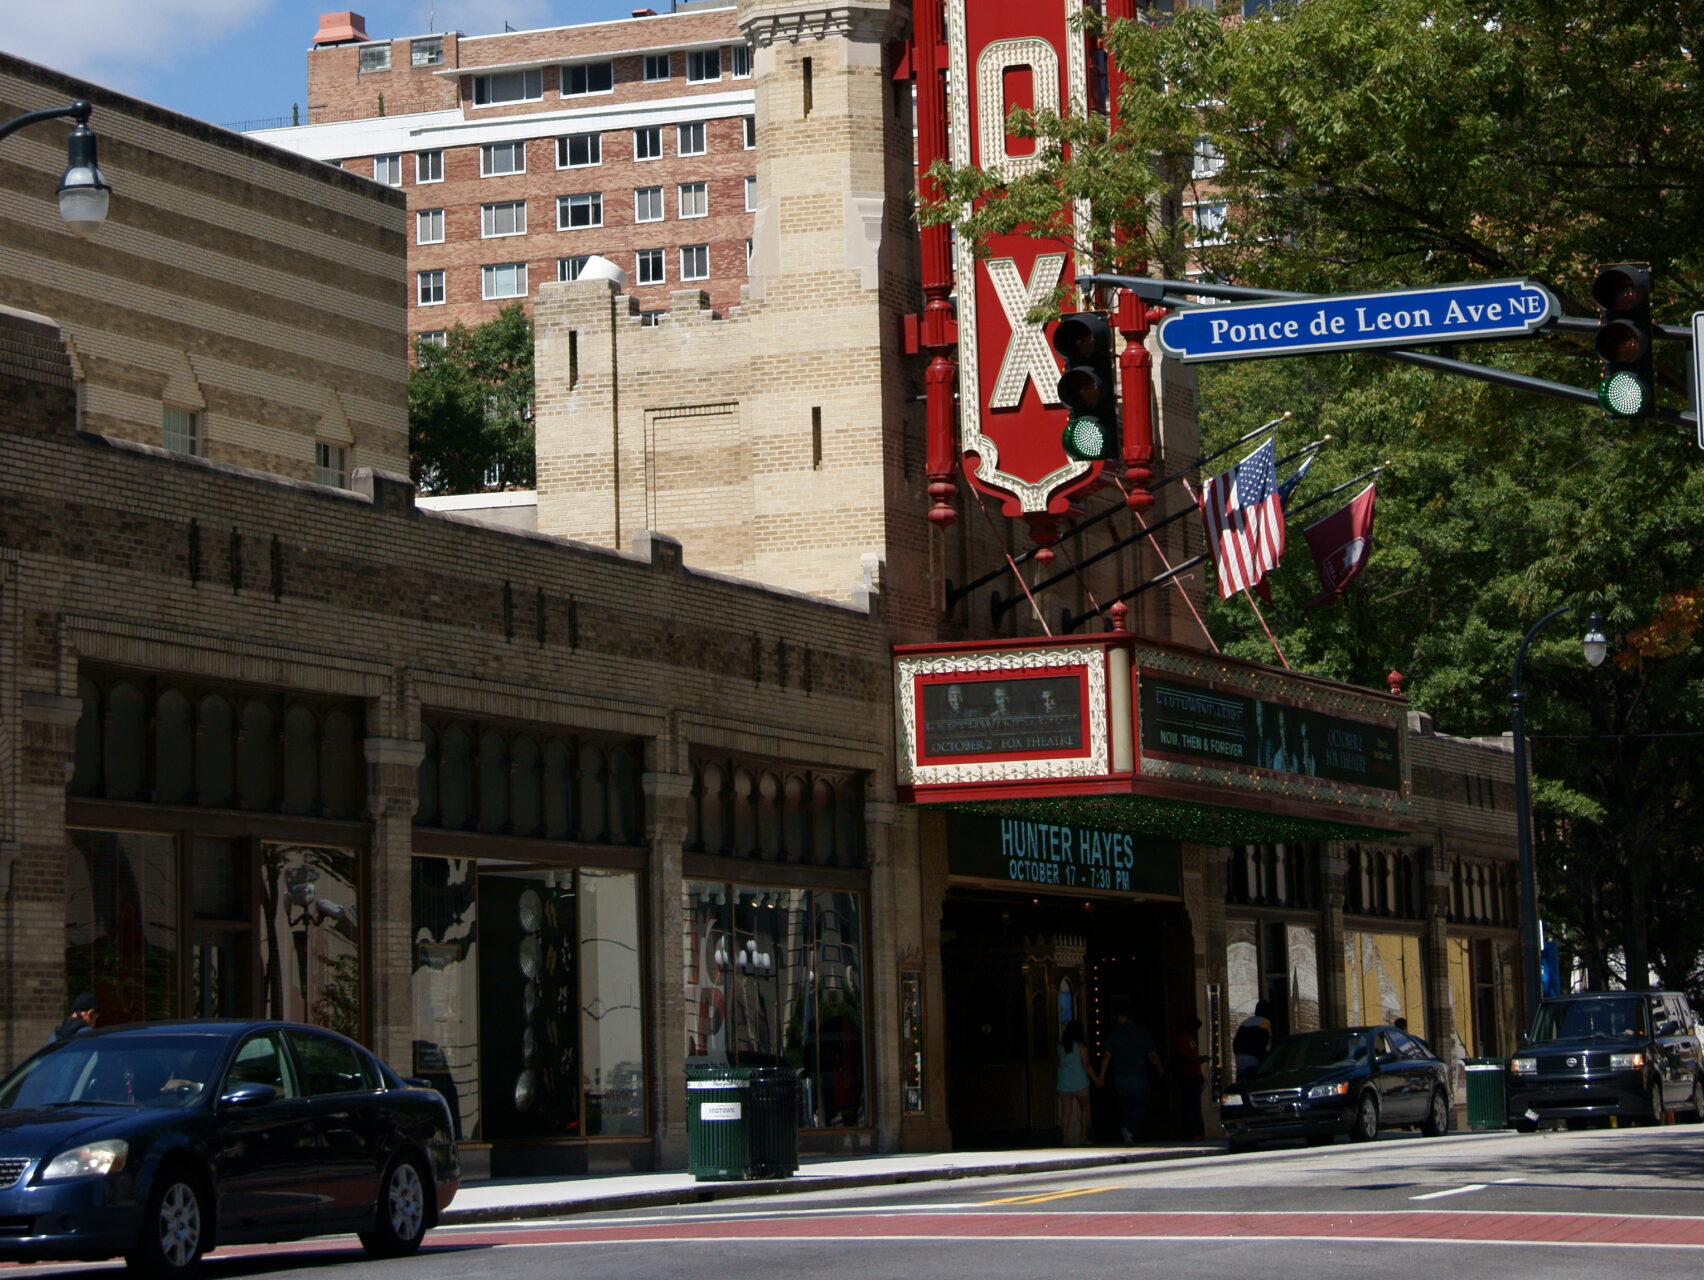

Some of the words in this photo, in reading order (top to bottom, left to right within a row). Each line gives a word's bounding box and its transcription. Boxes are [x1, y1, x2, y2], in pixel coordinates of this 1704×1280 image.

[1210, 318, 1299, 344] Ponce
[1309, 310, 1345, 336] de
[1356, 307, 1432, 332] Leon
[1443, 299, 1502, 325] Ave
[1508, 296, 1541, 315] NE
[931, 740, 984, 752] OCTOBER
[985, 740, 992, 750] 2
[1001, 738, 1022, 748] FOX
[1026, 736, 1074, 747] THEATRE
[1182, 734, 1202, 750] THEN
[1203, 737, 1209, 751] &
[1210, 738, 1244, 757] FOREVER
[1001, 819, 1073, 863] HUNTER
[1079, 829, 1134, 868] HAYES
[1009, 859, 1060, 884] OCTOBER
[1064, 866, 1076, 886] 17
[1090, 868, 1111, 889] 7:30
[1116, 871, 1130, 891] PM
